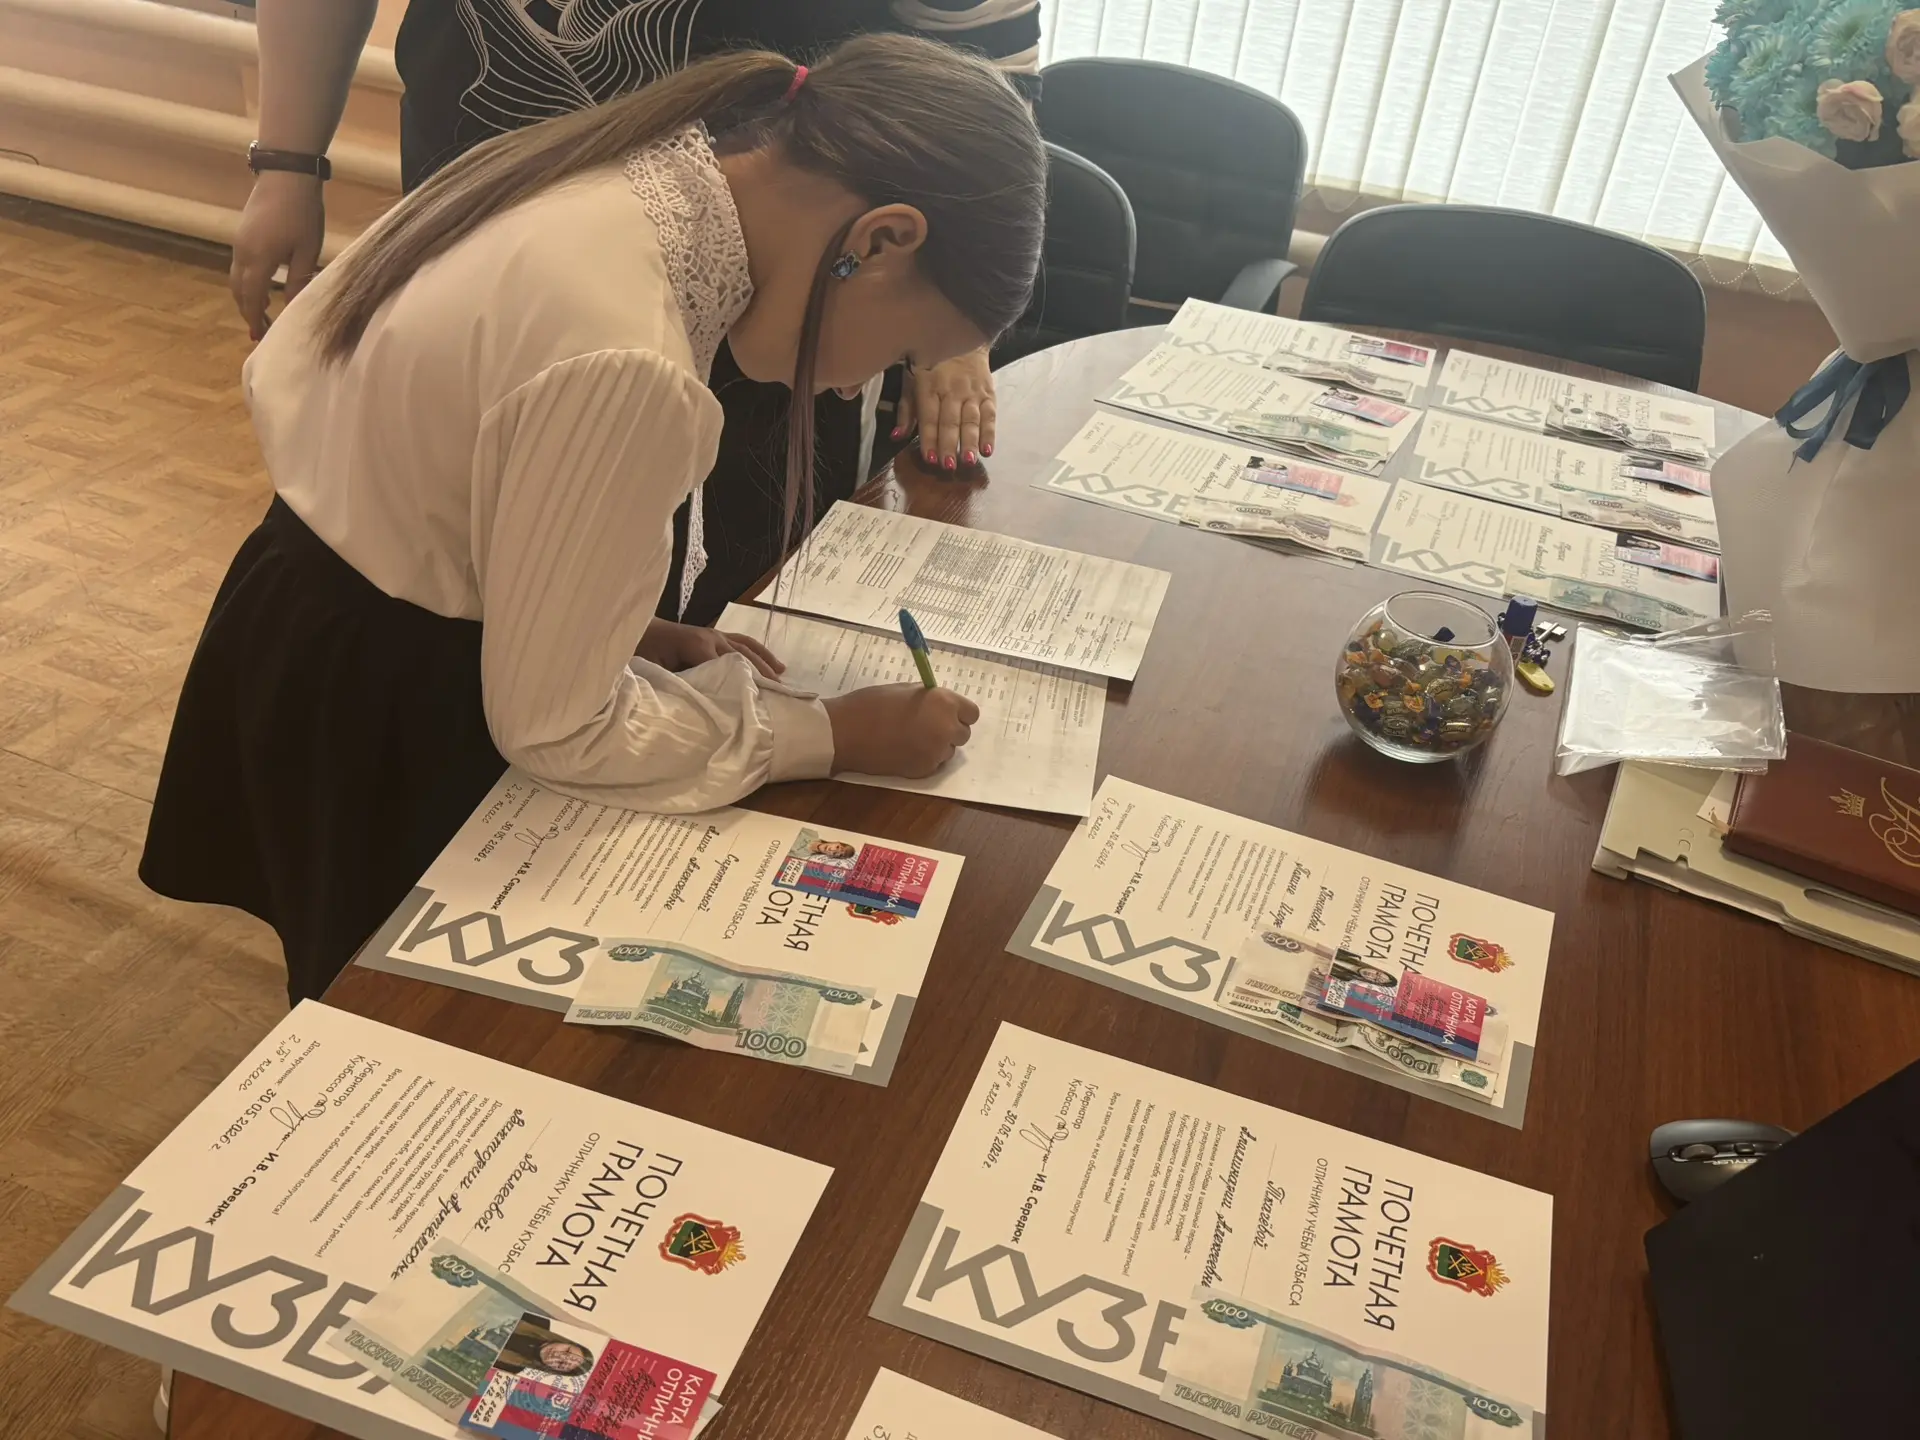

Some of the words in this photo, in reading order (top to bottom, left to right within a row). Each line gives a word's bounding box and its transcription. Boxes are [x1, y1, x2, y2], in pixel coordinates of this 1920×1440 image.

[884, 856, 916, 909] ОТЛИЧНИКА
[910, 859, 929, 887] КАРТА
[1264, 931, 1299, 950] 500
[1363, 883, 1407, 959] ГРАМОТА
[615, 942, 647, 958] 1000
[1041, 900, 1237, 1001] КУЗ
[826, 987, 858, 1002] 1000
[1441, 991, 1462, 1045] ОТЛИЧНИКА
[1462, 996, 1477, 1024] КАРТА
[302, 1040, 321, 1057] Дата
[734, 1025, 808, 1062] 1000
[1381, 1044, 1442, 1078] 1000
[239, 1058, 272, 1091] класс
[325, 1055, 366, 1093] Кузбасса
[333, 1060, 382, 1107] Губернатор
[1024, 1064, 1036, 1080] Дата
[220, 1088, 277, 1144] 30.05.2026
[980, 1081, 1000, 1116] класс
[1060, 1078, 1083, 1116] Кузбасса
[1071, 1083, 1099, 1130] Губернатор
[460, 1108, 525, 1189] Виктории
[987, 1110, 1018, 1163] 30.05.2026
[252, 1152, 279, 1173] И.В.
[553, 1132, 600, 1195] ОТЛИЧНИКУ
[1030, 1173, 1047, 1193] И.В.
[1219, 1126, 1257, 1209] Аполлинарии
[206, 1176, 256, 1226] Середюк
[474, 1153, 538, 1232] Валеевой
[536, 1140, 644, 1265] ГРАМОТА
[1307, 1158, 1328, 1218] ОТЛИЧНИКУ
[528, 1196, 559, 1229] УЧЁБЫ
[563, 1153, 683, 1312] ПОЧЕТНАЯ
[1011, 1196, 1038, 1244] Середюк
[1253, 1180, 1285, 1250] Ткачёвой
[1300, 1219, 1317, 1251] УЧЁБЫ
[1323, 1166, 1373, 1286] ГРАМОТА
[438, 1255, 475, 1281] 1000
[1364, 1179, 1413, 1331] ПОЧЕТНАЯ
[1288, 1252, 1310, 1306] КУЗБАССА
[1209, 1300, 1249, 1321] 1000
[343, 1328, 404, 1373] ТЫСЯЧА
[400, 1362, 466, 1410] РУБЛЕЙ
[666, 1373, 704, 1425] КАРТА
[1172, 1382, 1242, 1419] ТЫСЯЧА
[1471, 1396, 1512, 1419] 1000
